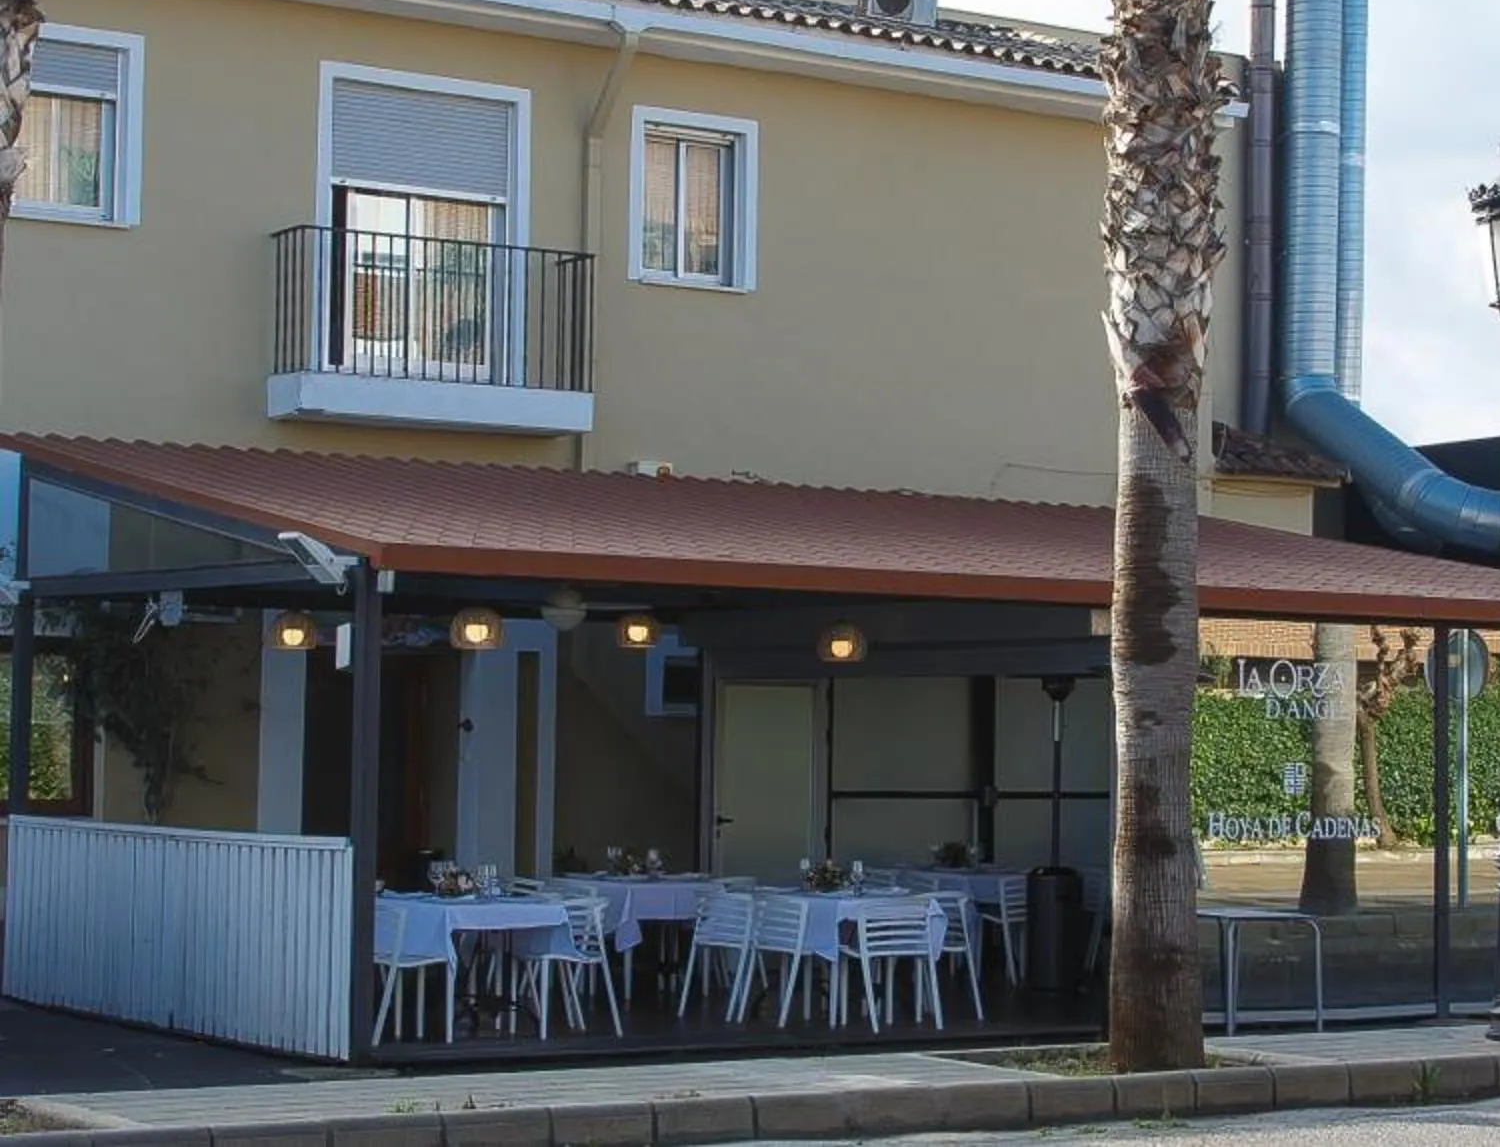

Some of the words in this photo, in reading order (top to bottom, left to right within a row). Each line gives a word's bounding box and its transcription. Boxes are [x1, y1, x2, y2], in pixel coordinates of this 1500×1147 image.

[1237, 658, 1266, 699] LA
[1269, 659, 1344, 700] ORZA
[1208, 810, 1263, 840] HOYA
[1267, 815, 1293, 839] DE
[1296, 810, 1382, 840] CADENAS
